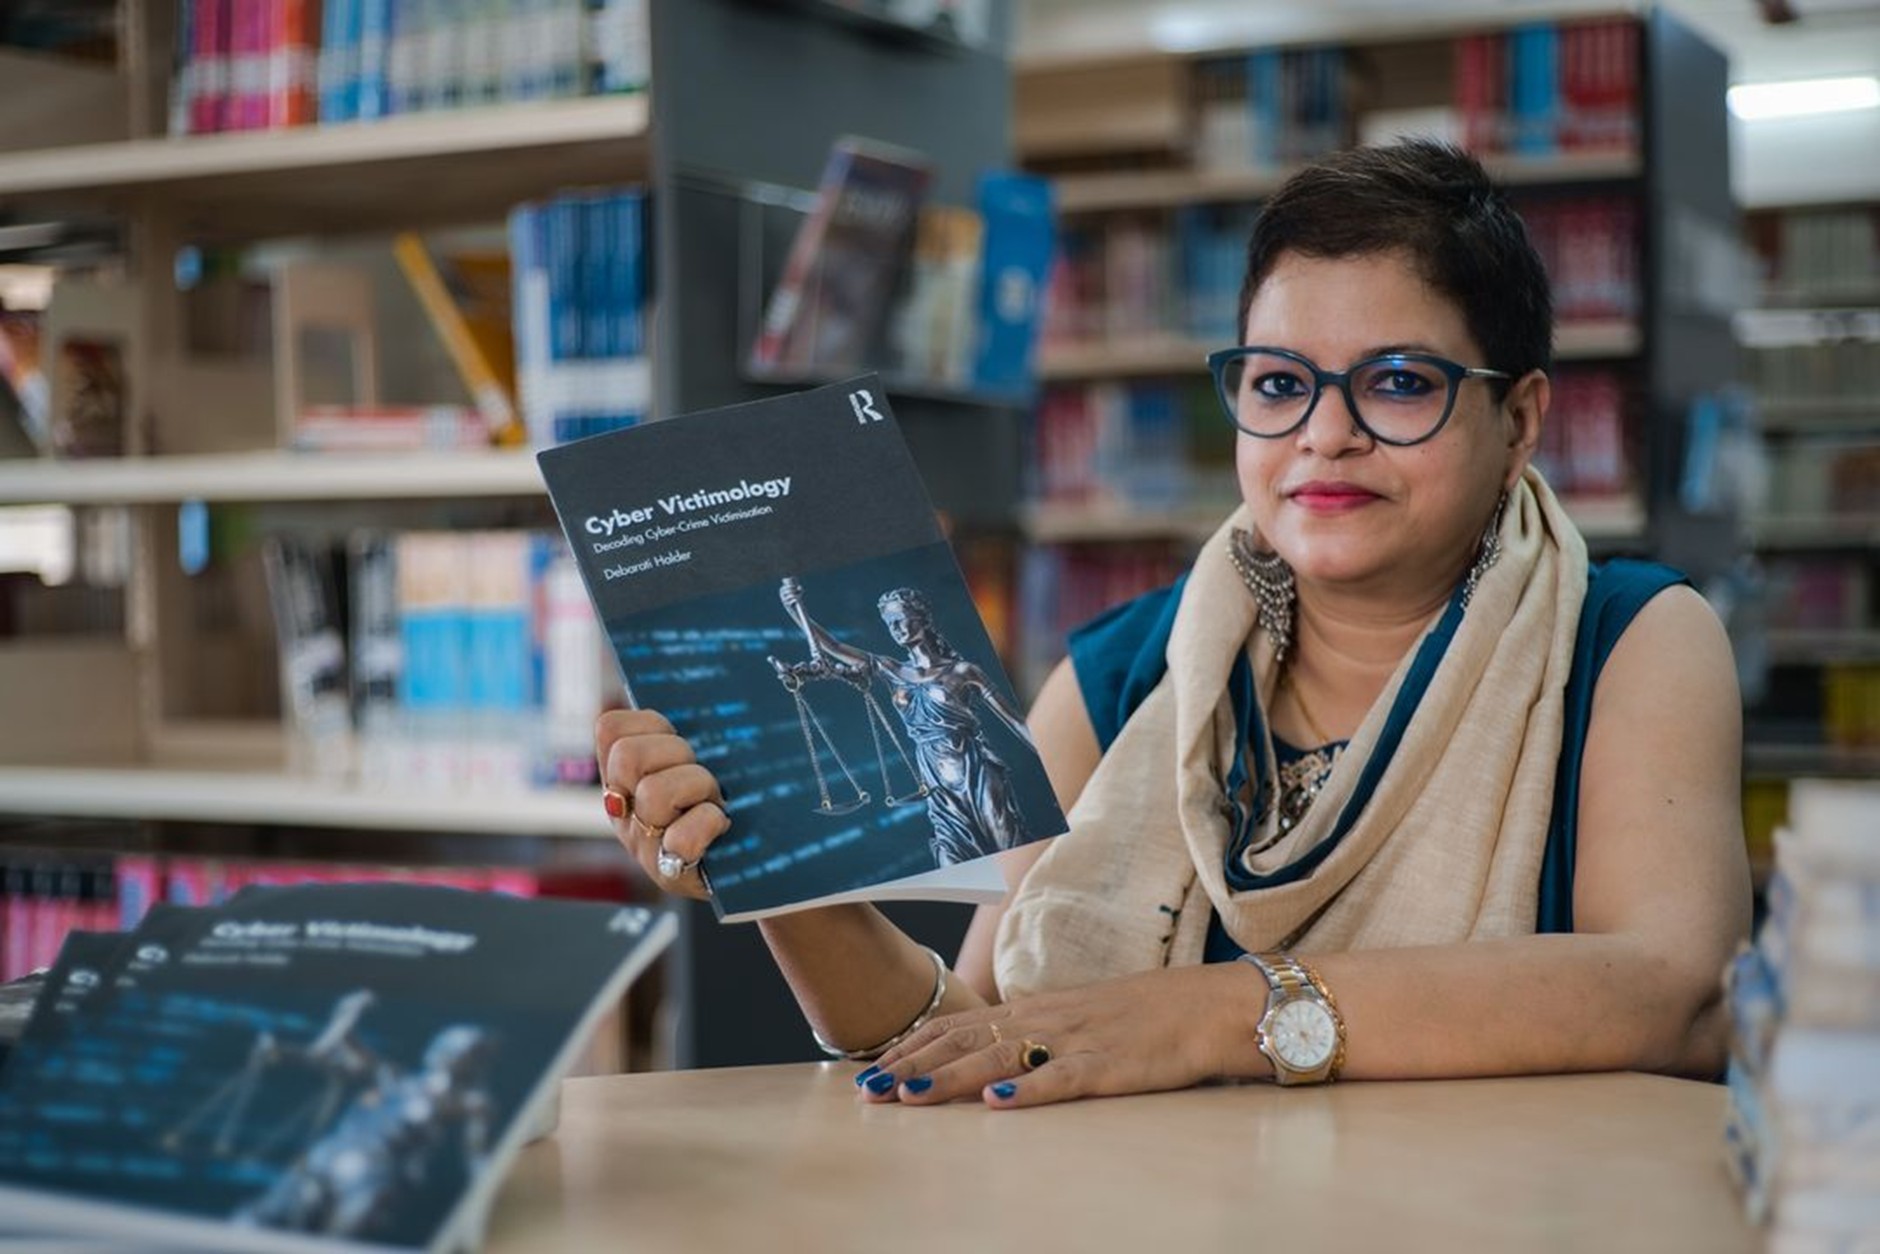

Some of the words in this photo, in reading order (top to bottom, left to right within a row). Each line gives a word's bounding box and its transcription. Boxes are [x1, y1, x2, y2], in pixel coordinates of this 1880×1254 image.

[849, 389, 883, 425] R
[585, 508, 655, 537] Cyber
[657, 476, 791, 516] Victimology
[592, 534, 645, 554] Decoding
[644, 517, 710, 541] Cyber-Crime
[709, 505, 773, 525] Victimisation
[603, 558, 653, 581] Debarati
